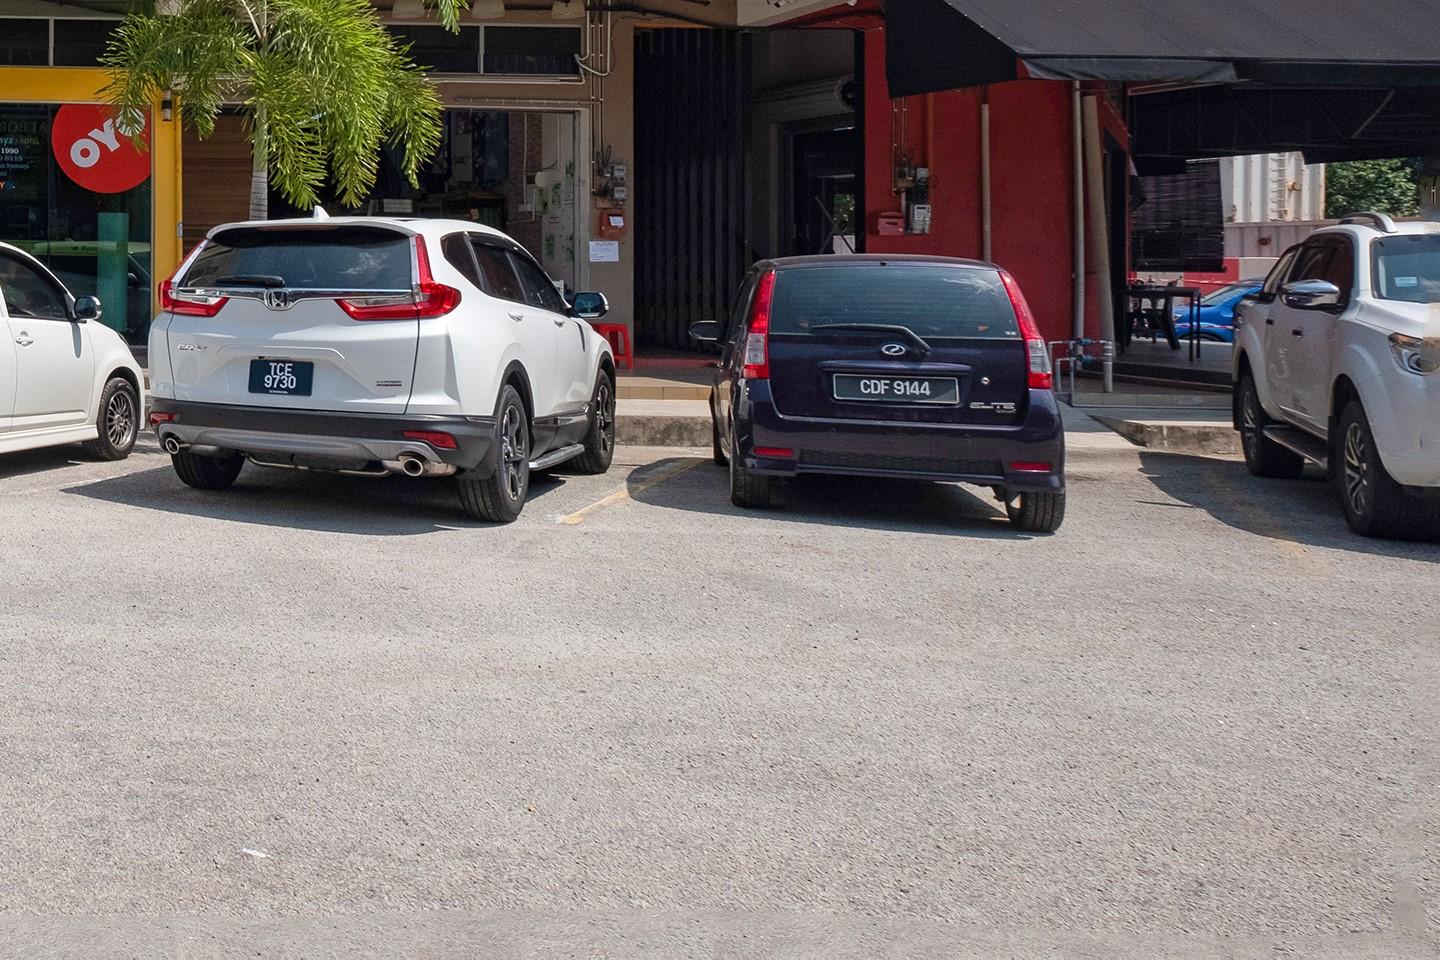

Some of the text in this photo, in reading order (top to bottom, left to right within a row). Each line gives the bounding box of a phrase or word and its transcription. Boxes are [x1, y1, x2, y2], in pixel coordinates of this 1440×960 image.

[269, 362, 293, 376] TCE
[264, 375, 297, 389] 9730
[860, 379, 931, 396] CDF 9144
